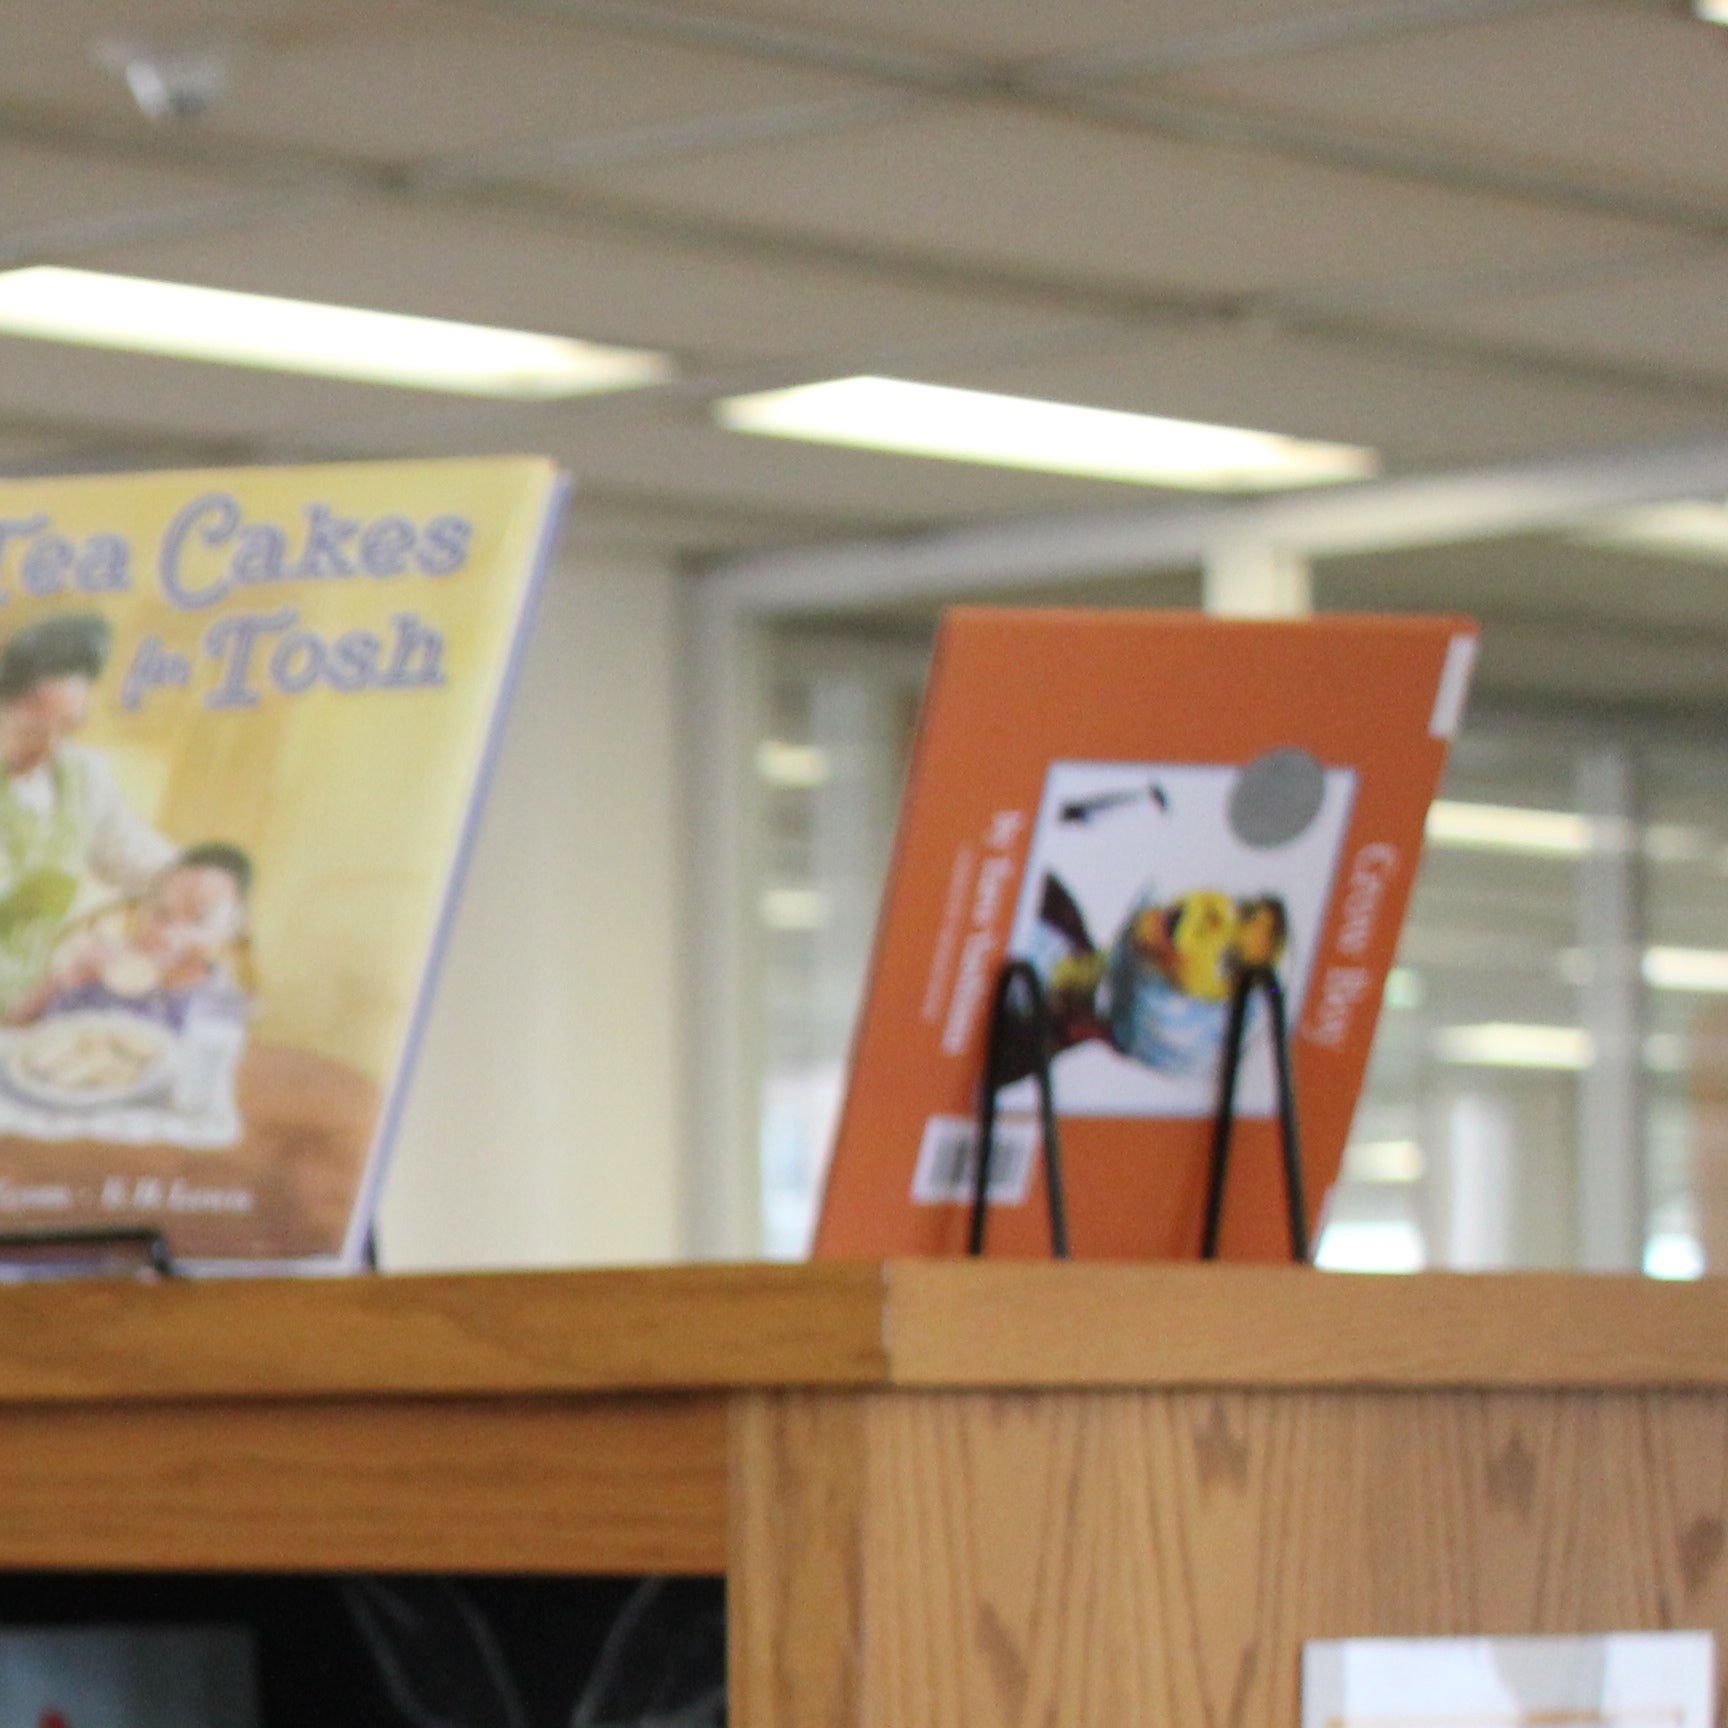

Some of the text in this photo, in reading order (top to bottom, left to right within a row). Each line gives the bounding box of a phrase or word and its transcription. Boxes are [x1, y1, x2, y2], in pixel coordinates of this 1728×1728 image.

[156, 490, 473, 612] Cakes
[200, 604, 450, 710] Tosh
[1298, 966, 1370, 1045] Boy
